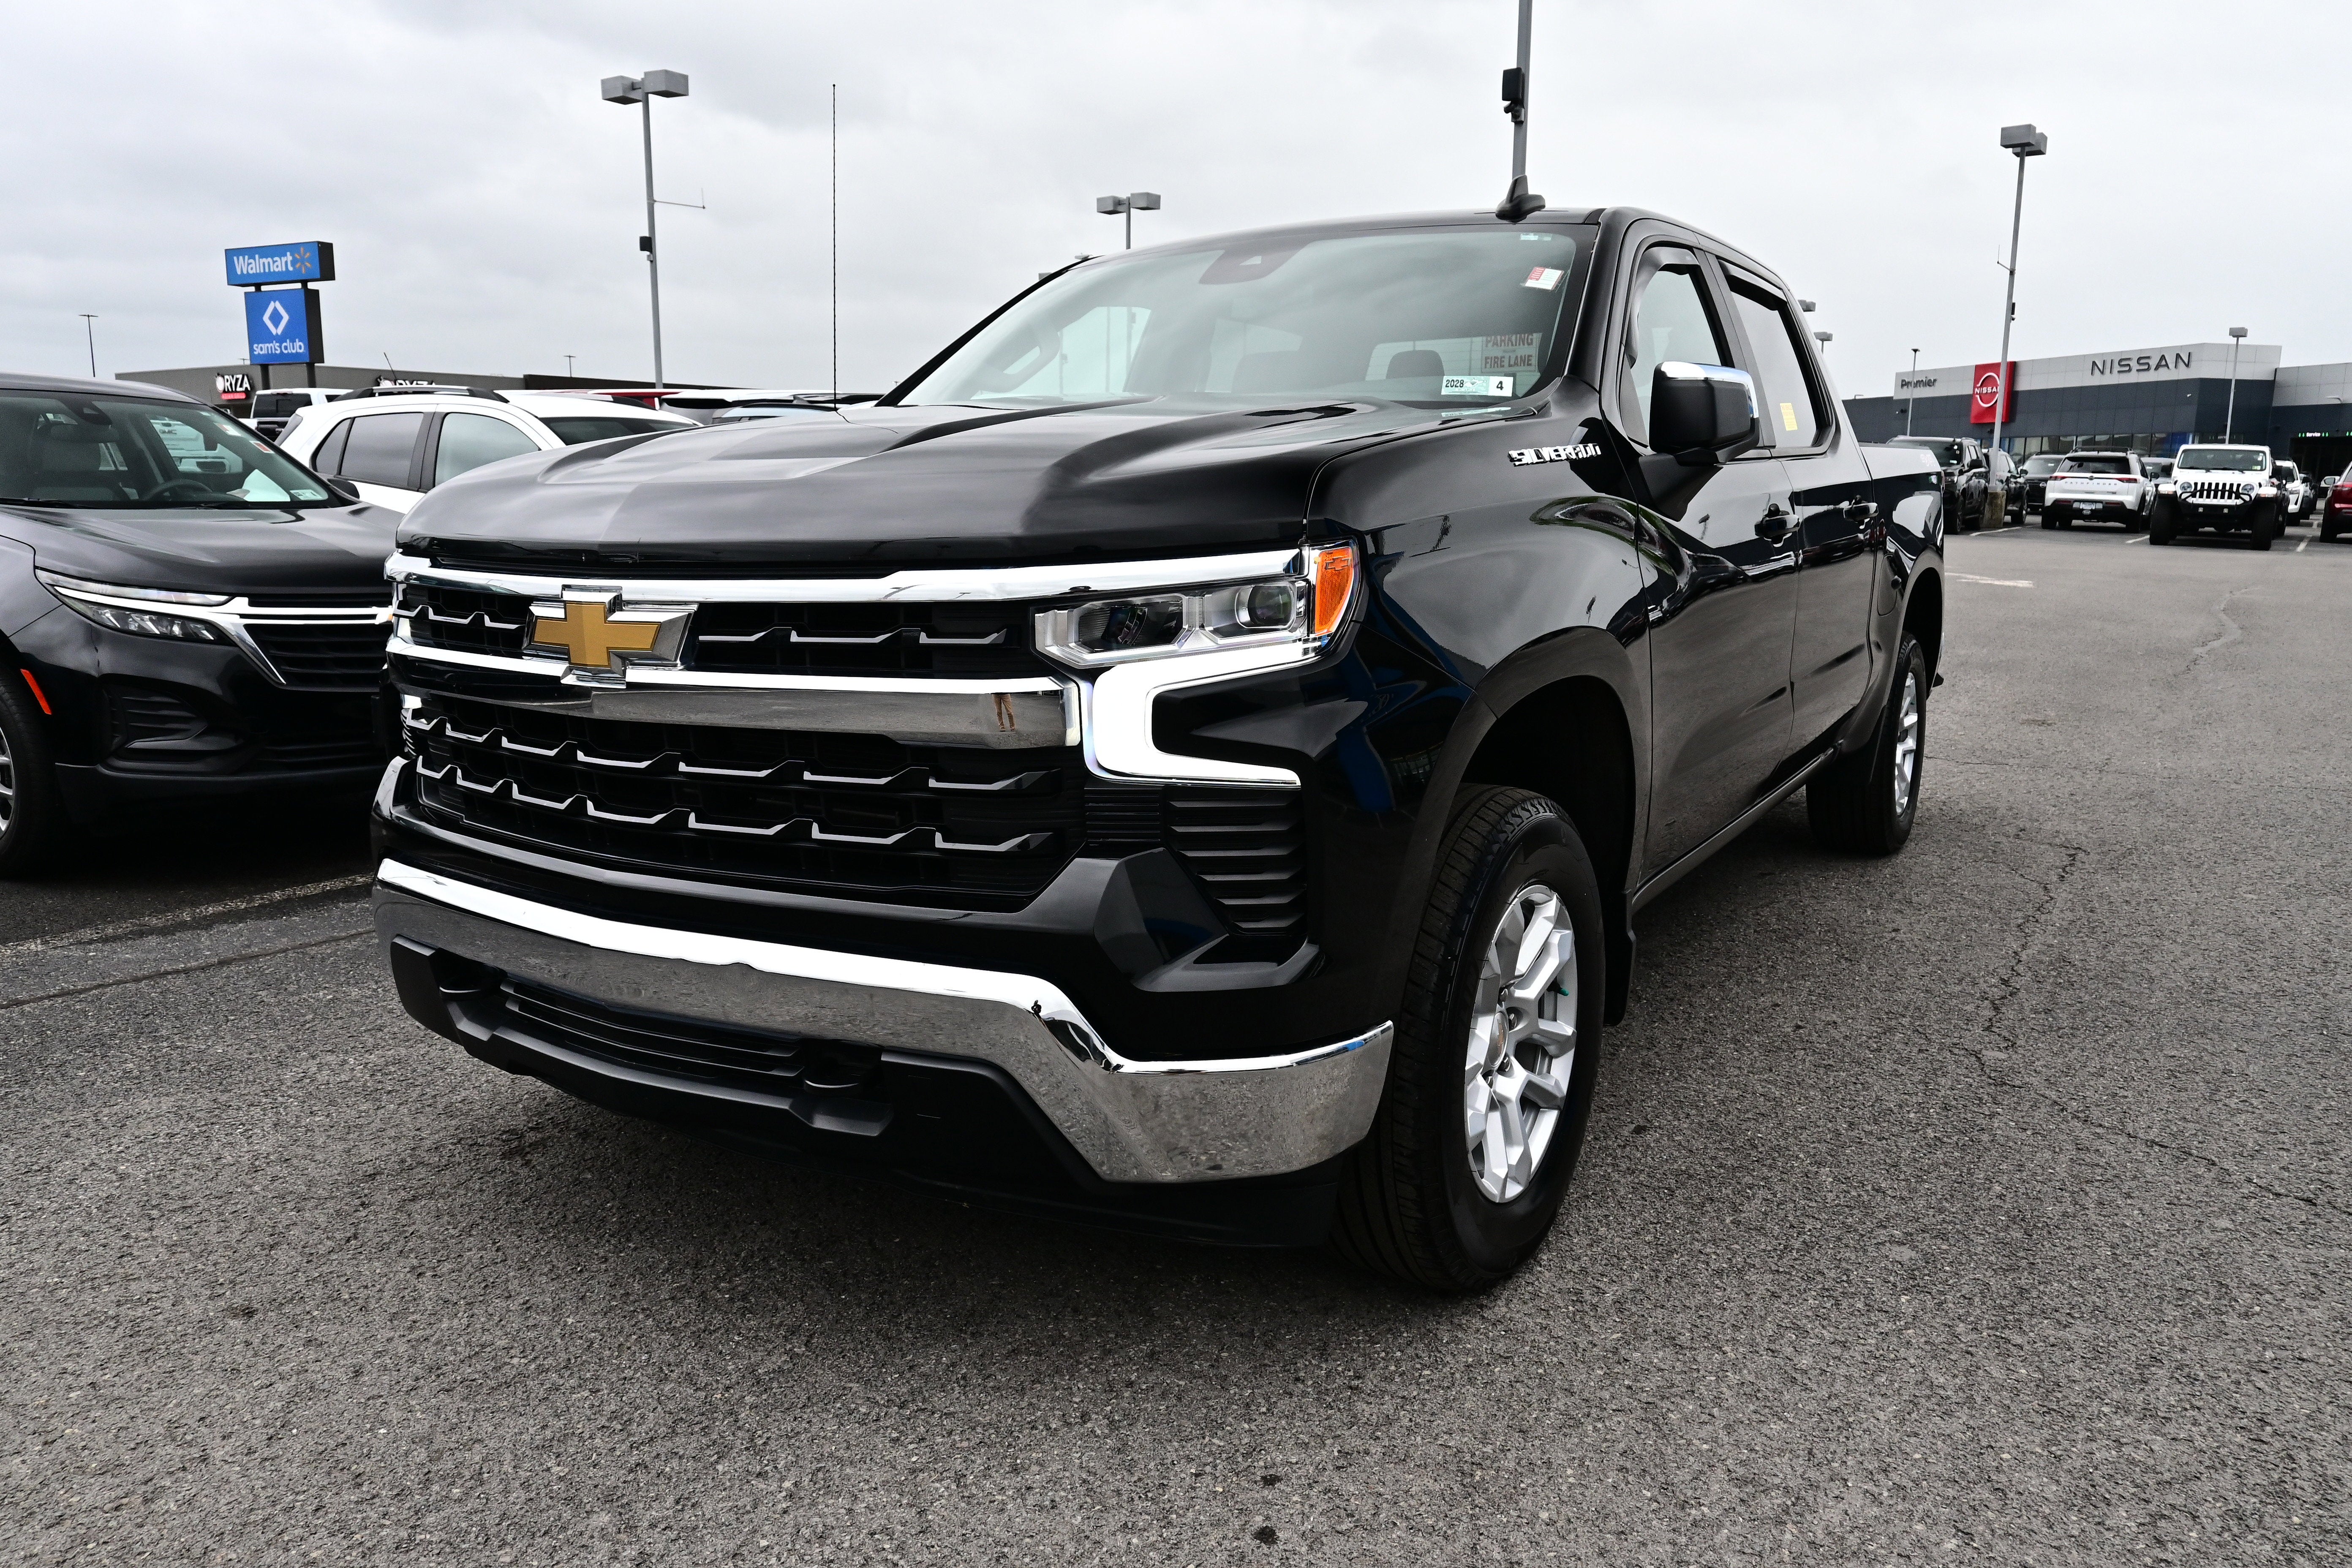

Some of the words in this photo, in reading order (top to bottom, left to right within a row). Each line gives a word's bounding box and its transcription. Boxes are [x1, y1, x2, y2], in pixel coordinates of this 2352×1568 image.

[233, 251, 294, 275] Walmart
[253, 340, 280, 354] sam's
[282, 338, 304, 353] club
[1485, 333, 1534, 348] PARKING
[1484, 355, 1505, 368] FIRE
[1508, 354, 1533, 368] LANE
[2091, 351, 2192, 376] NISSAN
[1445, 379, 1464, 388] 2028
[1496, 381, 1504, 390] 4
[1508, 443, 1602, 467] SILVERADO
